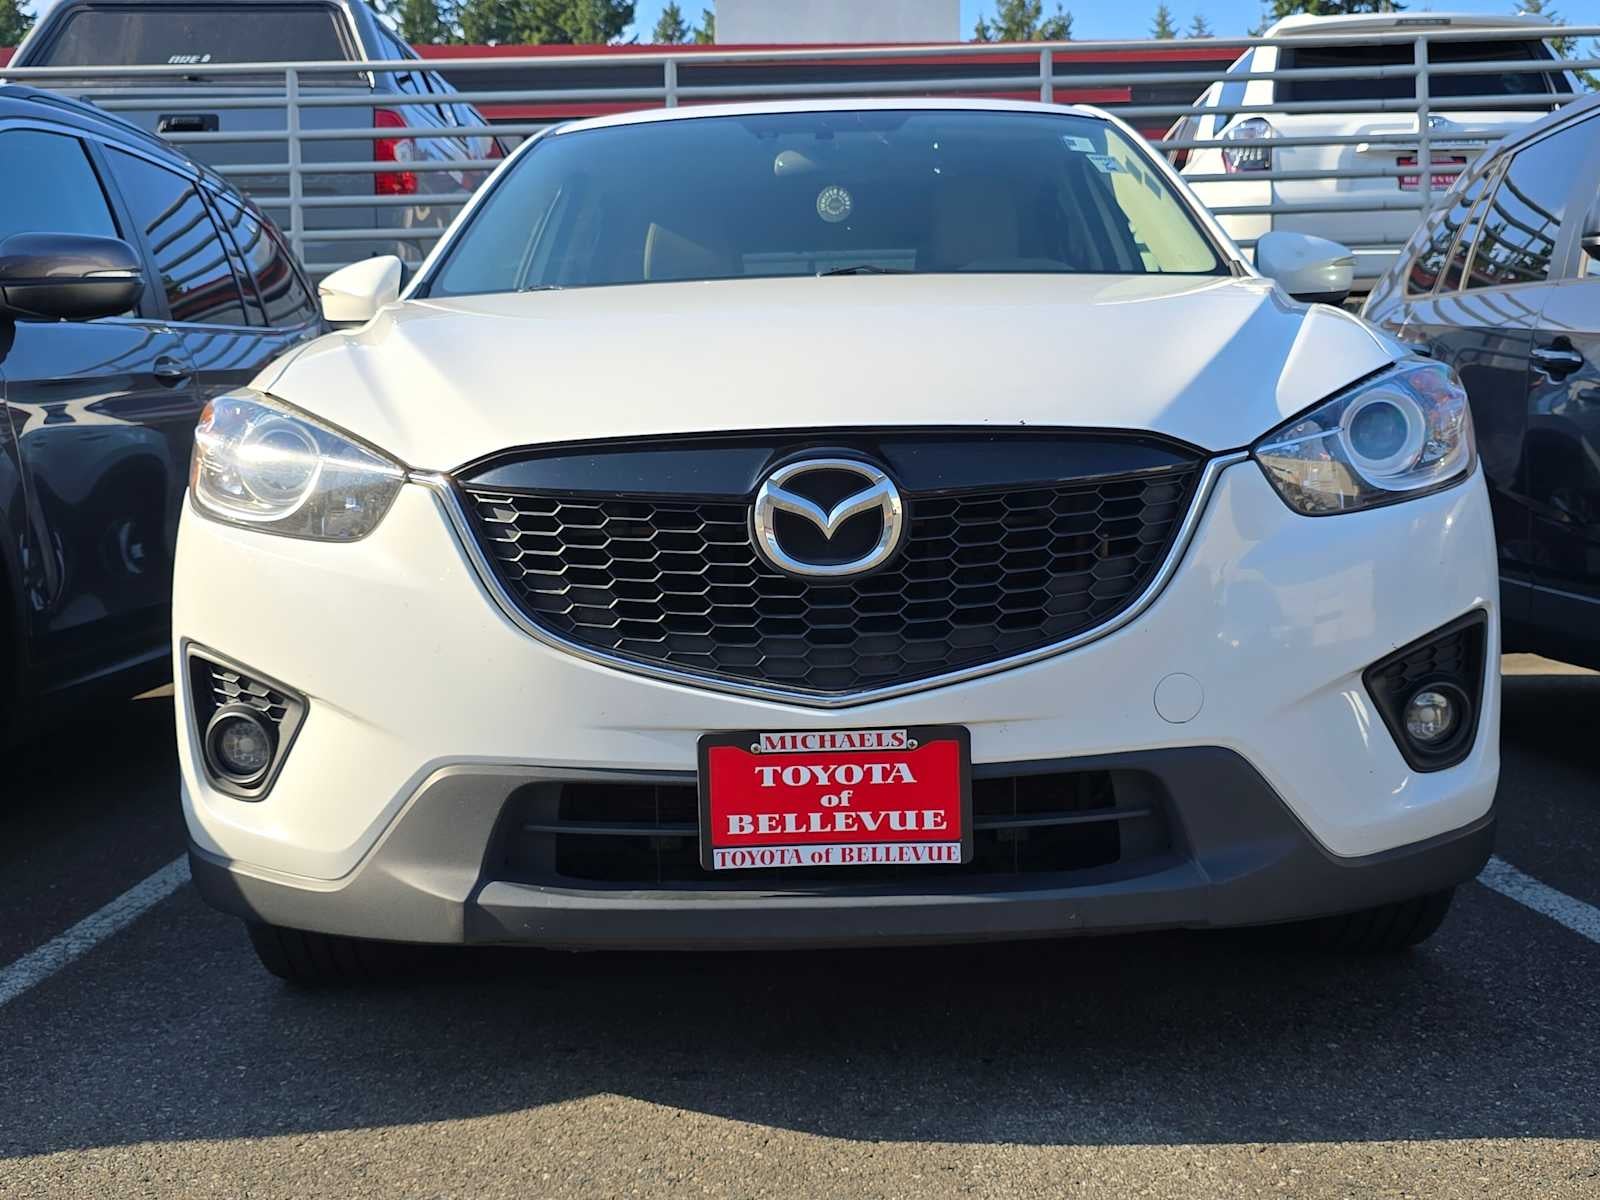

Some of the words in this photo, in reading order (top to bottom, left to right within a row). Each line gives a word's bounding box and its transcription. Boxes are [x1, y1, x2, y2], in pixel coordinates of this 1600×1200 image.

[764, 732, 905, 750] MICHAELS
[754, 763, 917, 787] TOYOTA
[820, 791, 853, 807] of
[727, 810, 948, 835] BELLEVUE
[716, 849, 801, 867] TOYOTA
[810, 848, 835, 863] of
[841, 844, 960, 864] BELLEVUE
